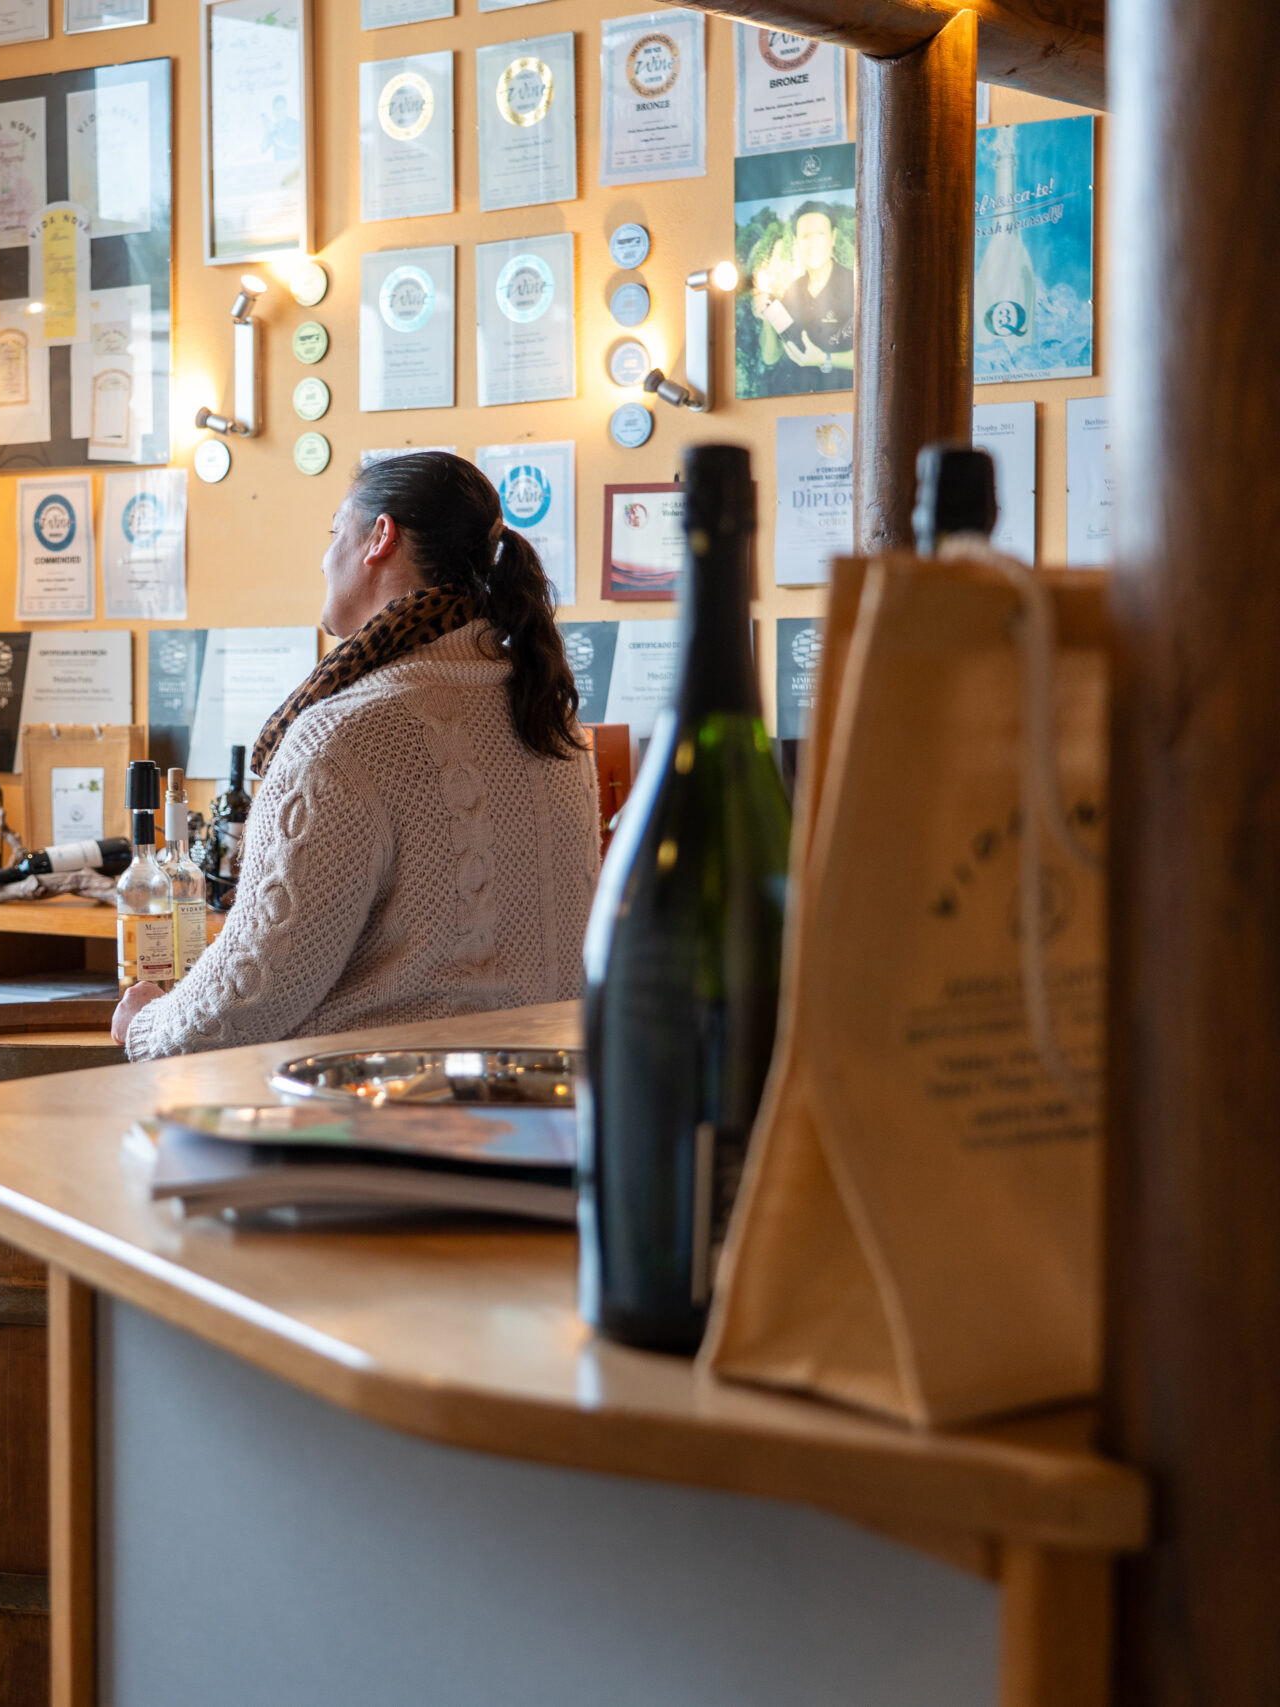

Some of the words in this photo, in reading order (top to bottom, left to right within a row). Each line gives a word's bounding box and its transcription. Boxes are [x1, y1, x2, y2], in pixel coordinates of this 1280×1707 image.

[769, 74, 809, 88] BRONZE
[636, 100, 670, 111] BRONZE
[10, 119, 37, 140] NOVA
[29, 215, 55, 239] VIDA
[975, 221, 1002, 237] resh
[977, 424, 998, 433] Trophy
[792, 488, 854, 508] DiPLO
[34, 555, 81, 565] COMMENDED
[629, 641, 671, 650] CERTIFICADO
